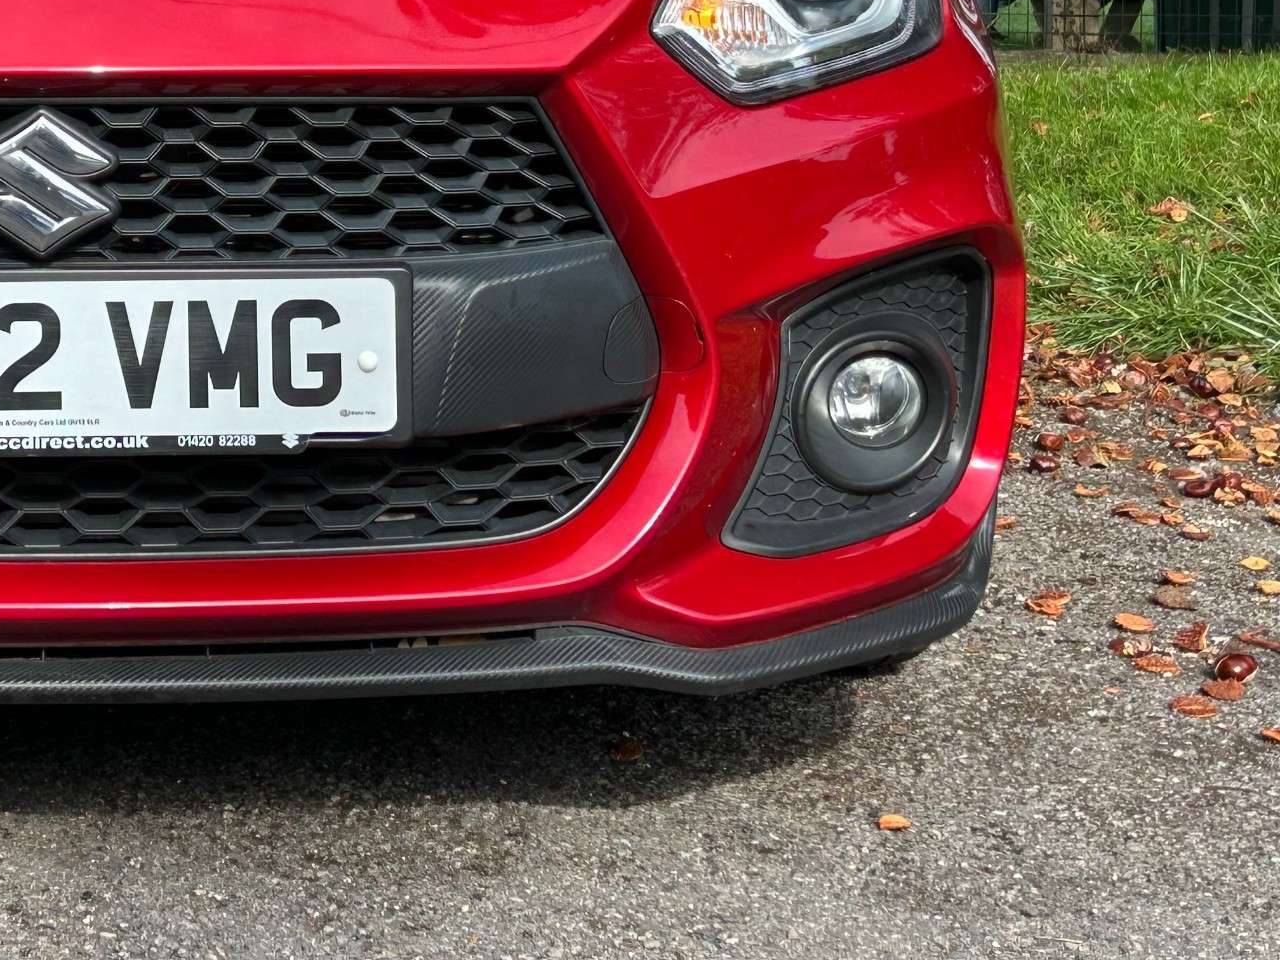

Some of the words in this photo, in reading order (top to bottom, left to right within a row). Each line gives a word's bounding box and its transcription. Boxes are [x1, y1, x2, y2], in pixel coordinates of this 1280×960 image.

[105, 298, 342, 410] VMG
[177, 435, 214, 447] 01420
[218, 435, 257, 447] 82288
